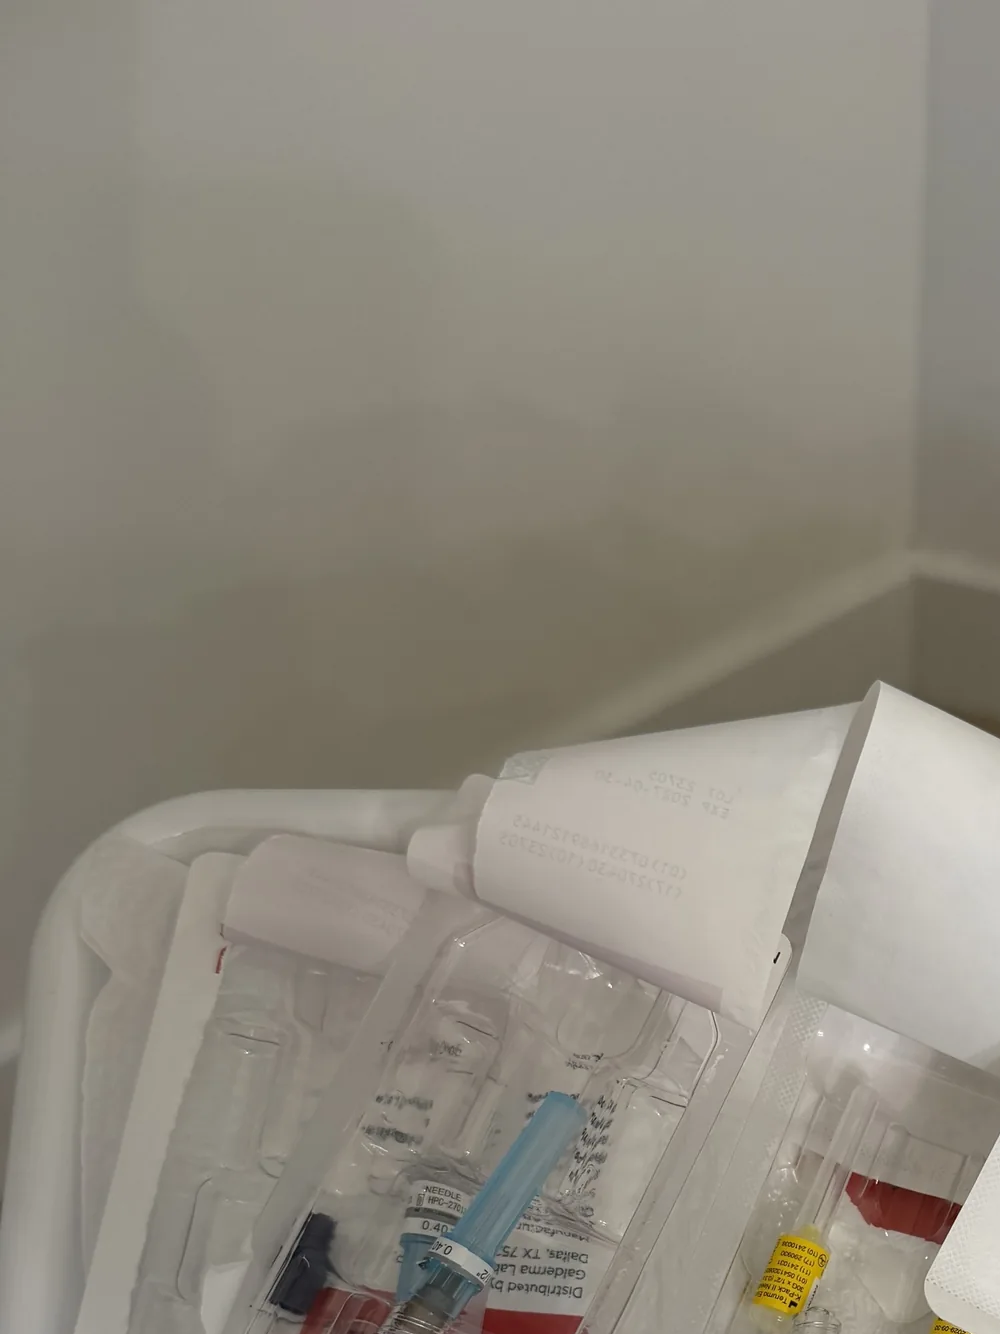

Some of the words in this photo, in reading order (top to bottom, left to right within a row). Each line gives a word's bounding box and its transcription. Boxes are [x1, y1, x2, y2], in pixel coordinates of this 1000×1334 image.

[424, 1184, 462, 1202] NEEDLE
[519, 1248, 541, 1260] TX
[520, 1265, 587, 1280] Galderma
[508, 1281, 583, 1299] Distributed
